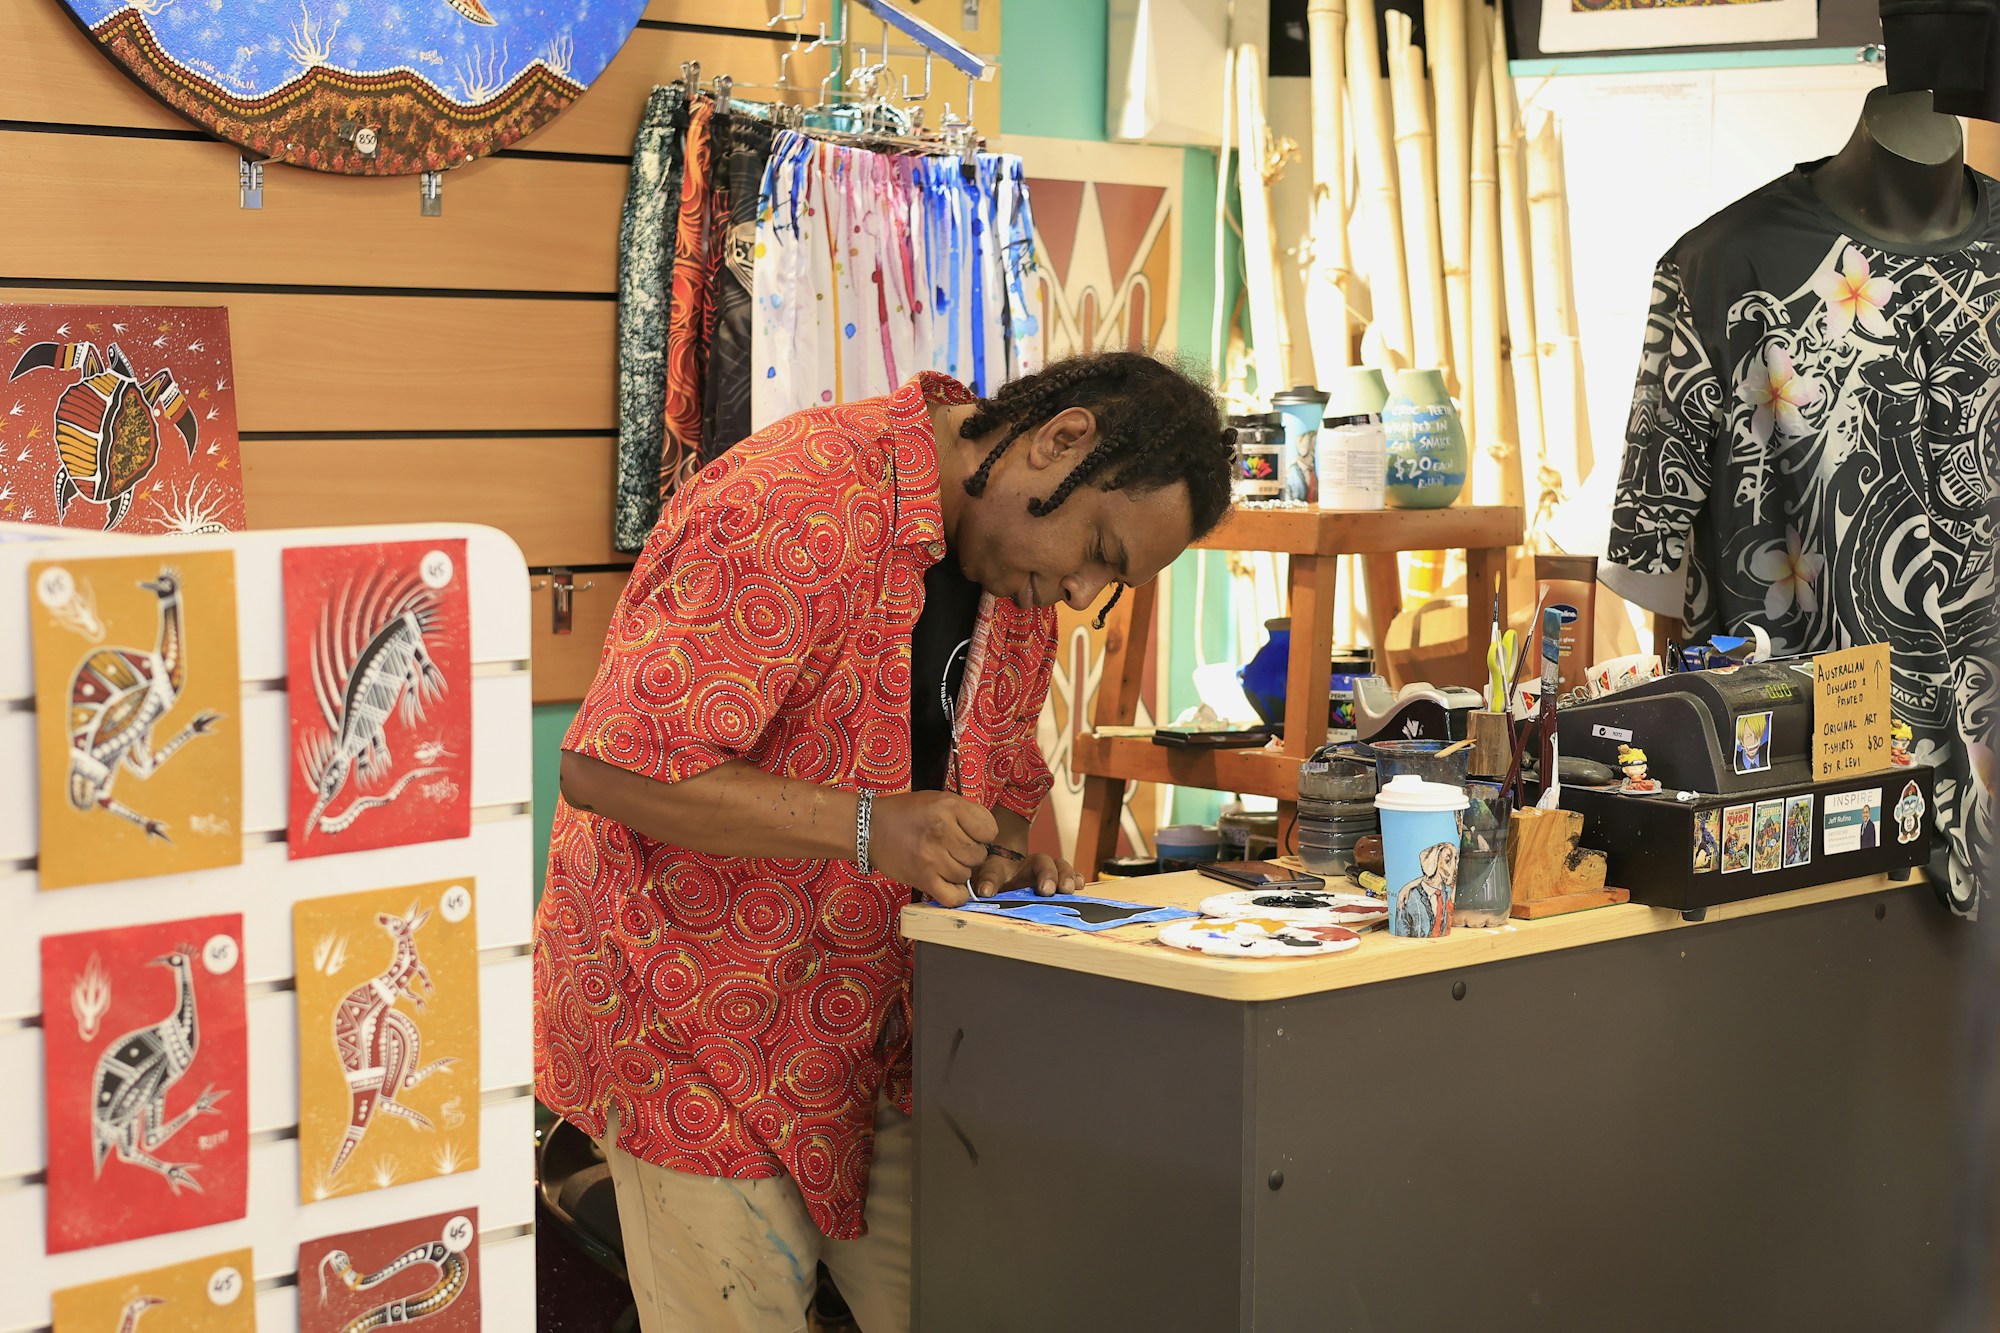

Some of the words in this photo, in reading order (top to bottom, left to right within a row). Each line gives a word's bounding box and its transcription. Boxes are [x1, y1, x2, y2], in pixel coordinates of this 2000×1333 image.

[215, 71, 256, 90] AUSTRALIA
[359, 134, 376, 144] 850
[1436, 420, 1448, 431] IN
[1390, 441, 1411, 453] SEA
[1419, 436, 1451, 449] SNAKE
[1394, 456, 1432, 481] $20
[1817, 659, 1865, 683] AUSTRALIAN
[1826, 679, 1857, 696] DESIGNED
[1837, 693, 1863, 708] PRINTED
[1823, 719, 1857, 736] ORIGINAL
[1864, 713, 1877, 727] ART
[1824, 739, 1854, 755] T-SHIRTS
[1867, 734, 1884, 753] $80
[1823, 762, 1833, 774] BY
[1845, 756, 1861, 769] LEVI
[1833, 791, 1873, 807] INSPIRE
[1727, 813, 1749, 825] THOR
[1827, 817, 1837, 825] Jeff
[1837, 815, 1852, 823] Rufino
[448, 894, 464, 910] 45
[450, 1222, 467, 1240] 45
[214, 1273, 237, 1292] 45
